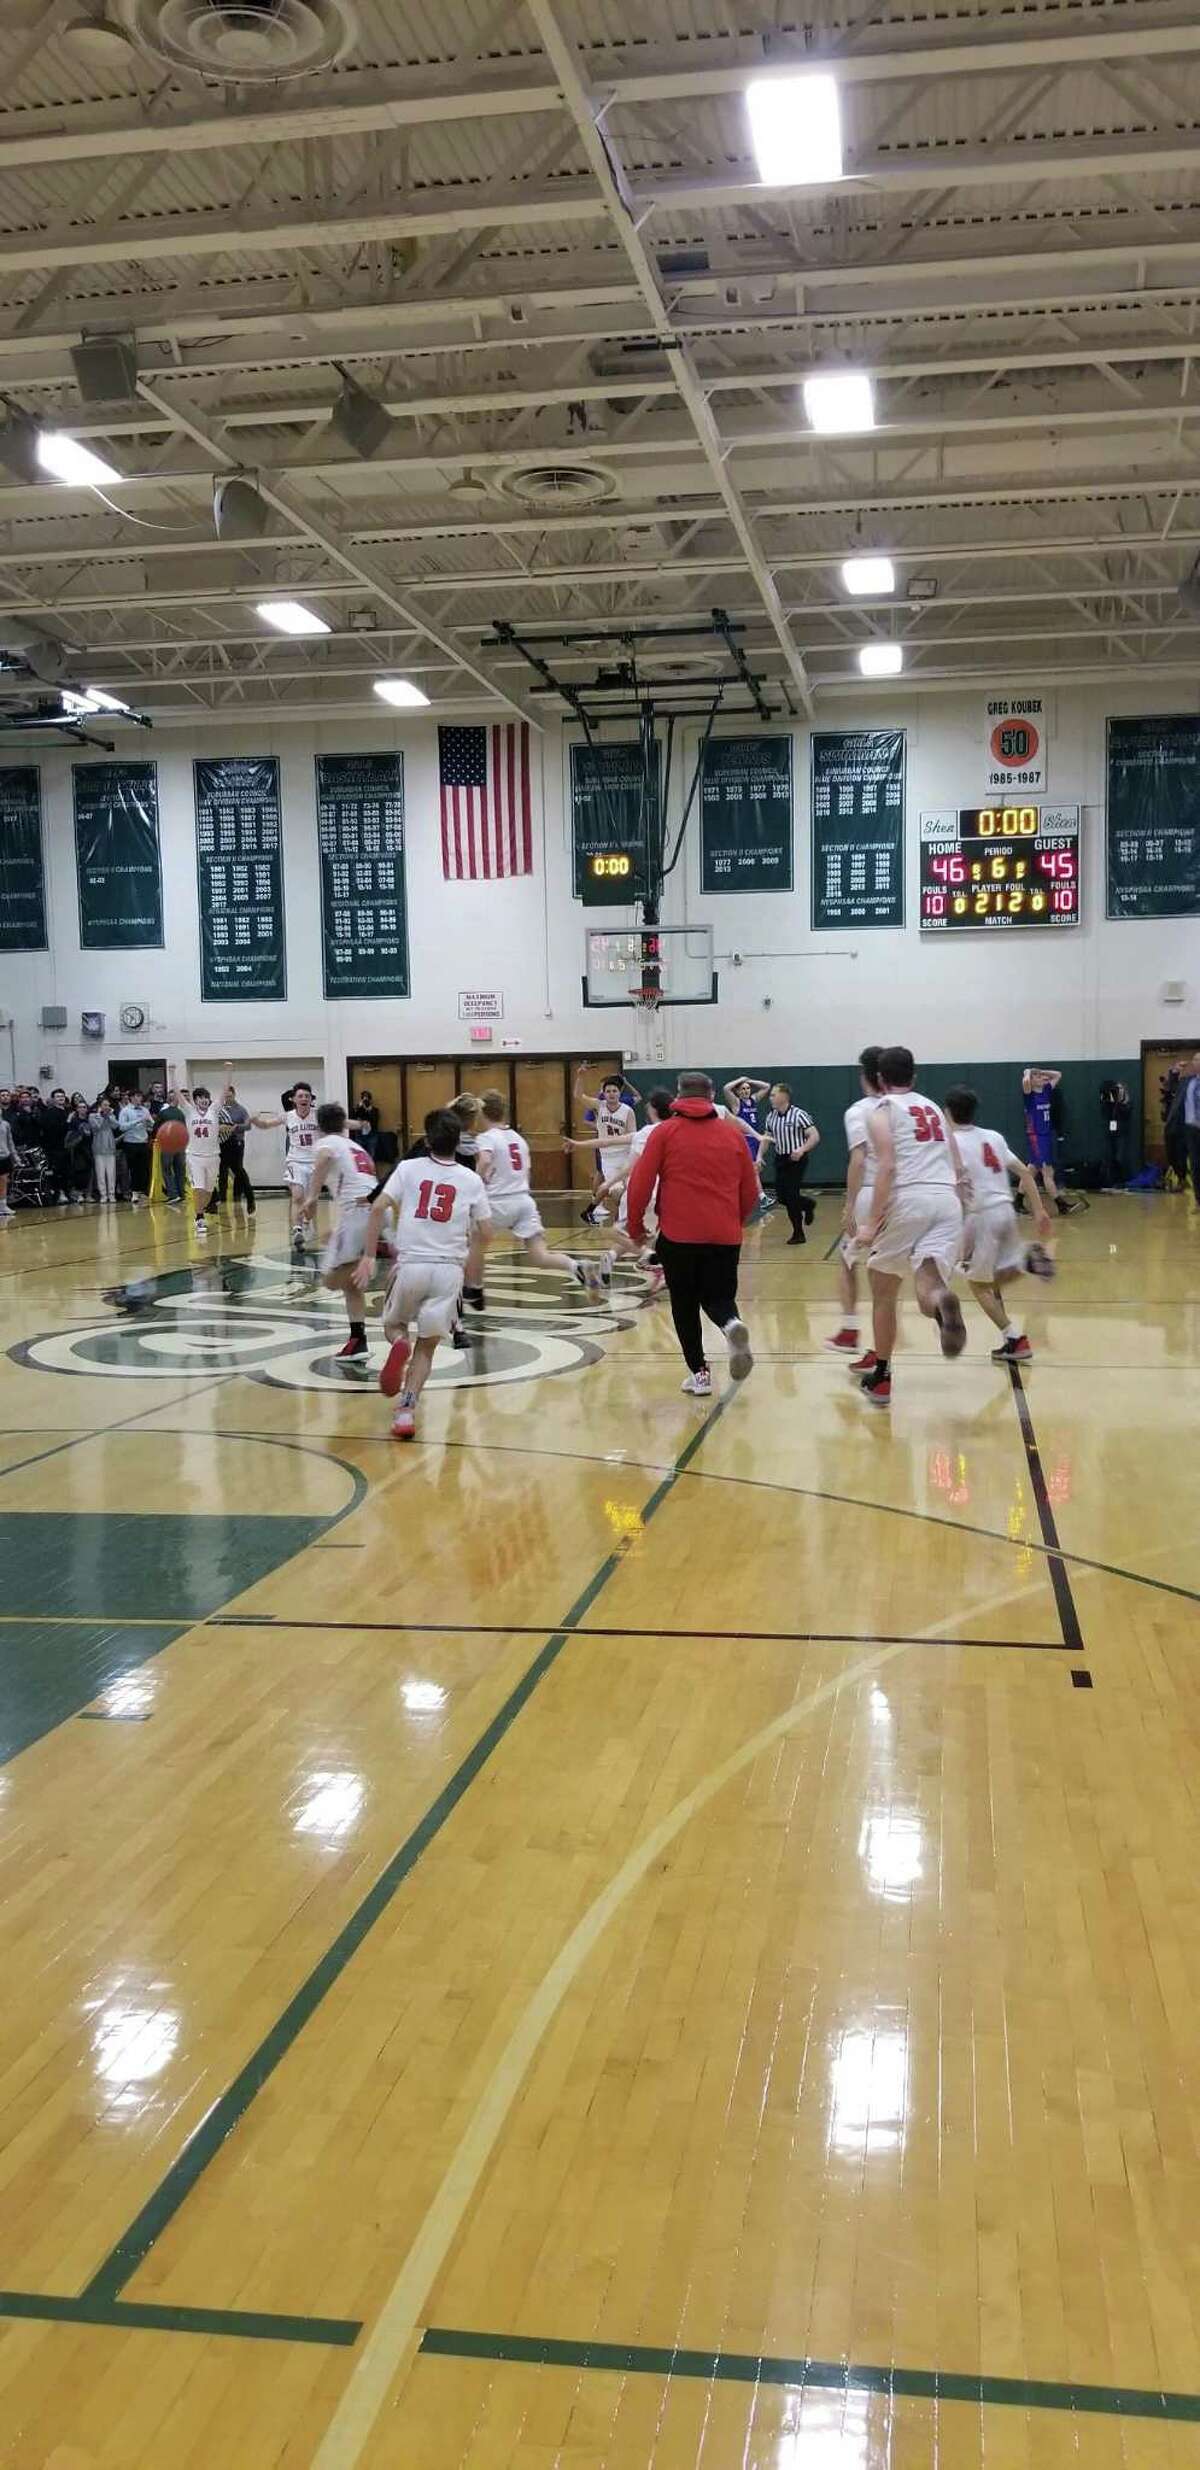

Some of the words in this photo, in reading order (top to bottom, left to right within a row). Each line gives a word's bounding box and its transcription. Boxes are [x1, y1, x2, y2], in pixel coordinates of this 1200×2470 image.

[988, 701, 1008, 715] GREG
[1001, 730, 1029, 757] 50
[989, 771, 1041, 785] 1985-1987
[979, 809, 1036, 836] 0:00
[929, 842, 962, 854] HOME
[984, 847, 1013, 856] PERIOD
[1034, 838, 1073, 850] GUEST
[594, 857, 629, 875] 0:00
[933, 858, 965, 882] 46
[992, 857, 1007, 879] 6
[1041, 853, 1074, 878] 45
[922, 886, 947, 894] FOULS
[972, 884, 1000, 893] PLAYER
[1006, 884, 1025, 892] FOUL
[1051, 881, 1076, 890] FOULS
[926, 895, 944, 914] 10
[954, 897, 967, 914] 0
[1032, 894, 1044, 911] 0
[1055, 890, 1073, 910] 10
[922, 919, 948, 927] SCORE
[985, 917, 1013, 925] MATCH
[1051, 914, 1077, 923] SCORE
[909, 1105, 945, 1142] 32
[508, 1143, 523, 1171] 5
[983, 1142, 1003, 1174] 4
[414, 1179, 456, 1223] 13
